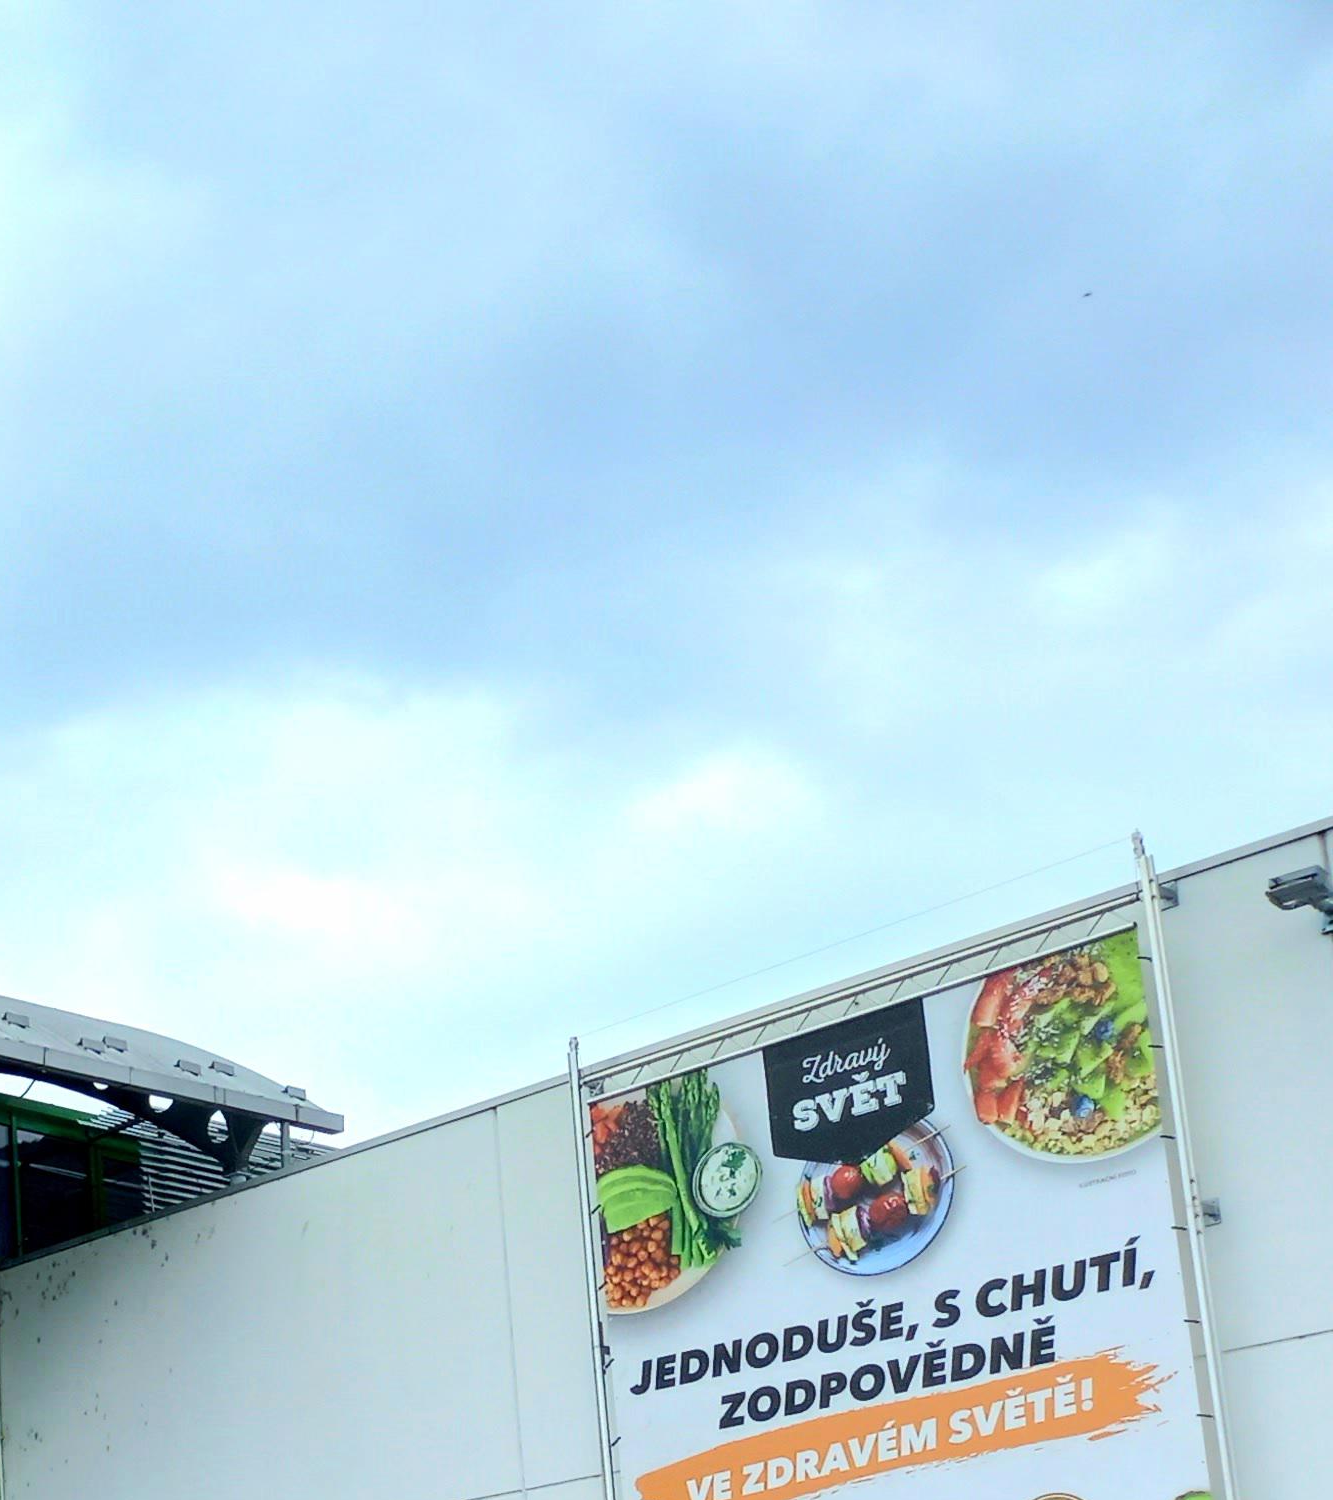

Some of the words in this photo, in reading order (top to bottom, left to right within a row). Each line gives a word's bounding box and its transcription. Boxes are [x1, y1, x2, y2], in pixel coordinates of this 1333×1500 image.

[792, 1070, 907, 1132] SVĚT
[802, 1038, 891, 1084] Zdravý
[630, 1299, 919, 1395] JEDNODUŠE,
[932, 1289, 961, 1329] S
[975, 1235, 1155, 1317] CHUTÍ,
[719, 1315, 1055, 1430] ZODPOVĚDNĚ
[741, 1418, 937, 1497] ZDRAVÉM
[948, 1373, 1093, 1444] SVĚTĚ!
